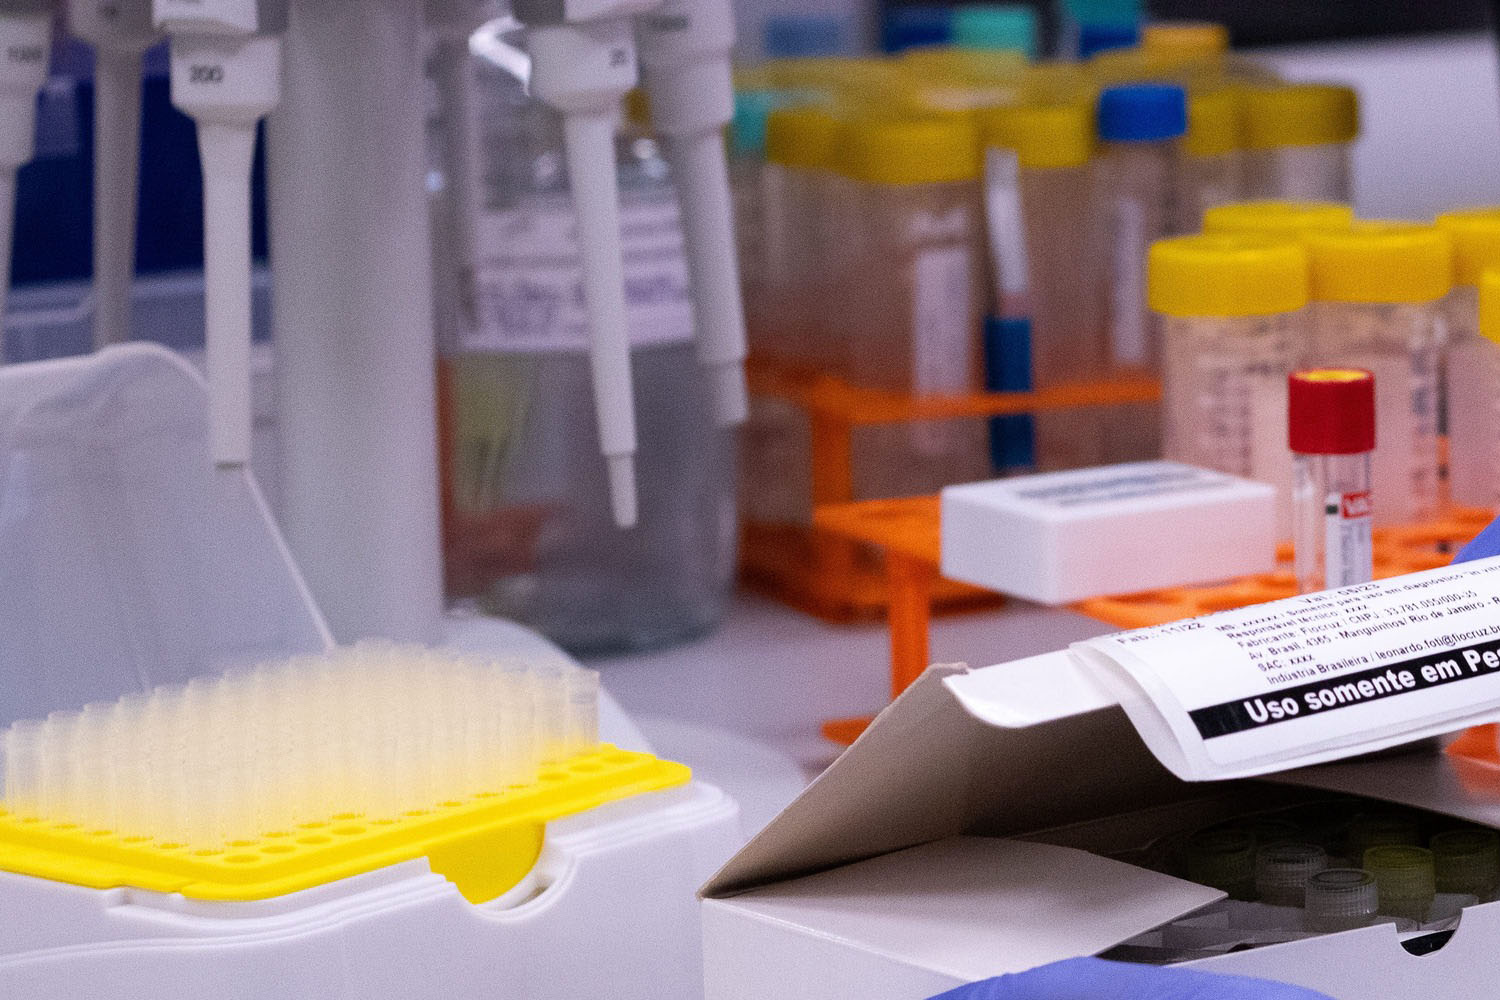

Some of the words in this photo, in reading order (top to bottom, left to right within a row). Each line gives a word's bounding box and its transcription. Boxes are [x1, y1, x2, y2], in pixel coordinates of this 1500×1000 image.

[1408, 613, 1428, 623] Rio
[1431, 608, 1444, 619] de
[1447, 601, 1485, 616] Janeiro
[1300, 621, 1341, 635] Fiocruz
[1317, 655, 1368, 674] Brasileira
[1243, 697, 1300, 723] Uso
[1304, 669, 1417, 710] somente
[1420, 656, 1463, 683] em
